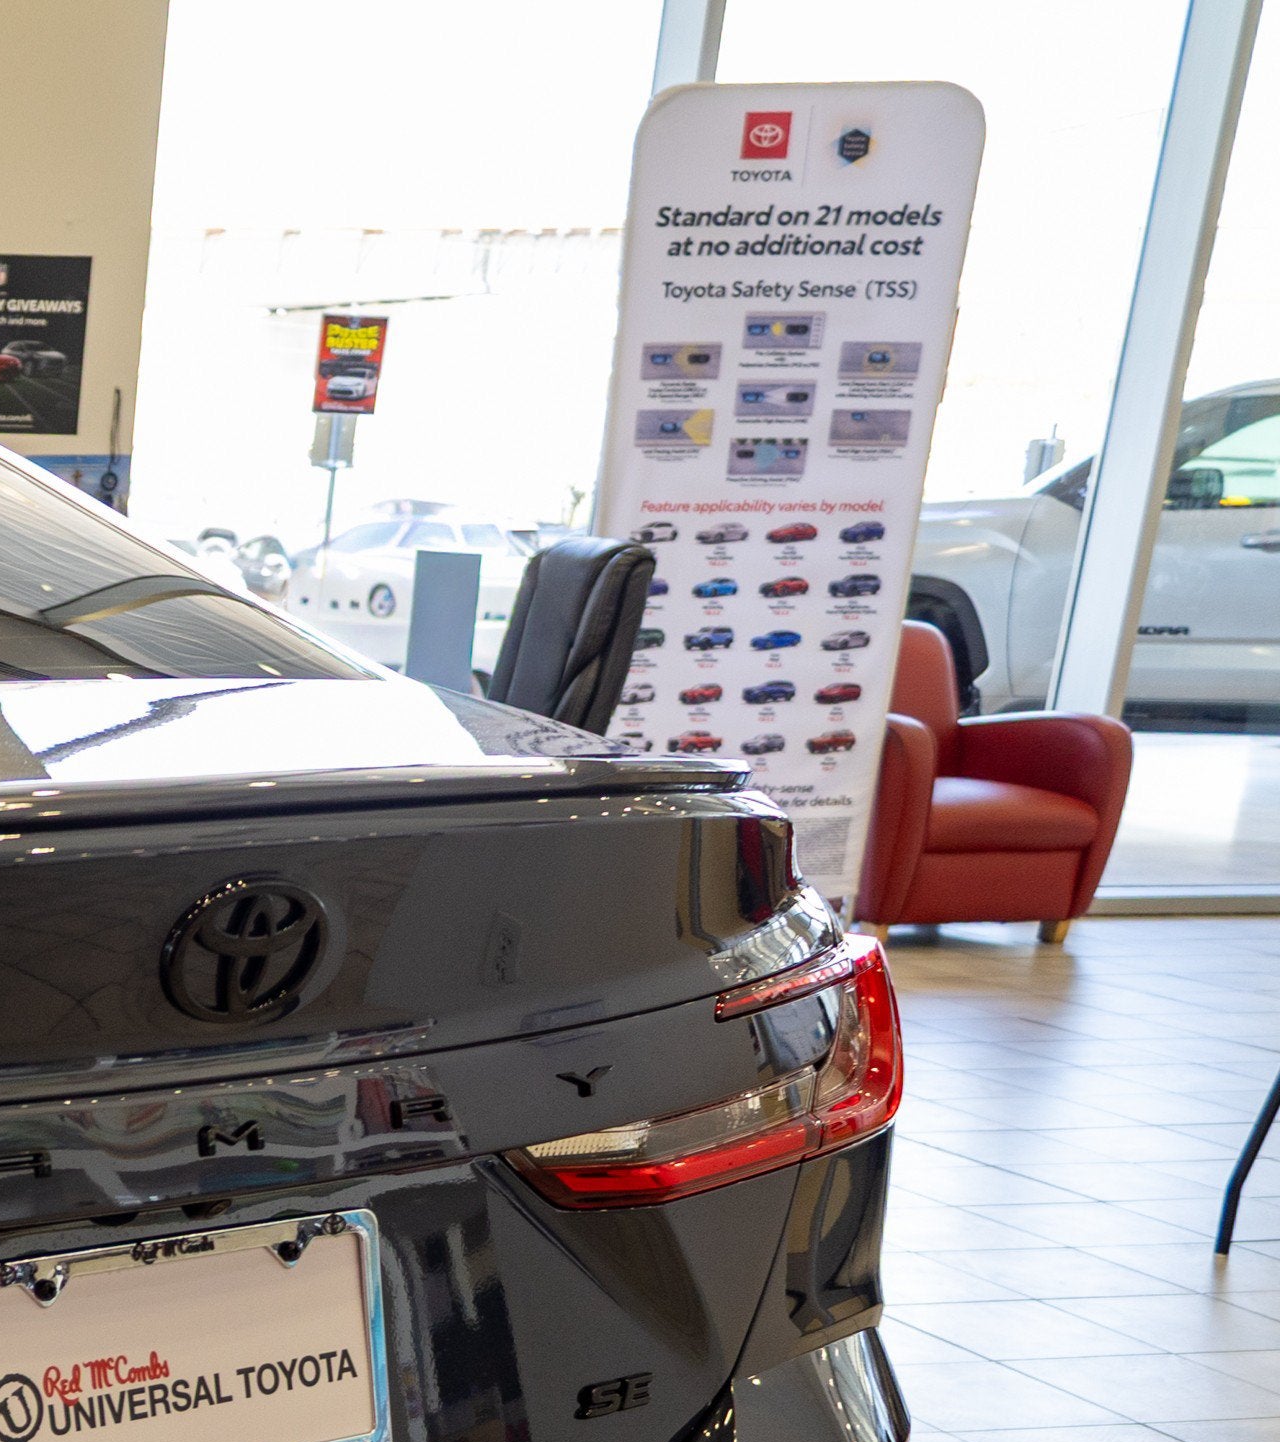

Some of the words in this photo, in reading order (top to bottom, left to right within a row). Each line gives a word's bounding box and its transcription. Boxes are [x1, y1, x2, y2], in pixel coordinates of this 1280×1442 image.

[731, 169, 792, 182] TOYOTA
[656, 205, 775, 228] Standard
[776, 209, 810, 226] on
[814, 204, 844, 226] 21
[846, 203, 943, 226] models
[667, 236, 694, 257] at
[696, 240, 730, 256] no
[734, 233, 866, 256] additional
[870, 235, 925, 256] cost
[662, 280, 726, 302] Toyota
[731, 279, 794, 302] Safety
[797, 280, 857, 298] Sense
[864, 279, 918, 301] (TSS)
[7, 299, 83, 314] GIVEAWAYS
[640, 500, 690, 513] Feature
[692, 499, 775, 515] applicability
[778, 500, 817, 513] varies
[820, 499, 835, 515] by
[839, 499, 884, 513] model
[809, 795, 853, 807] details
[42, 1363, 83, 1407] Red
[83, 1350, 171, 1390] McCombs
[47, 1371, 234, 1436] UNIVERSAL
[236, 1348, 359, 1396] TOYOTA
[573, 1371, 654, 1420] SE
